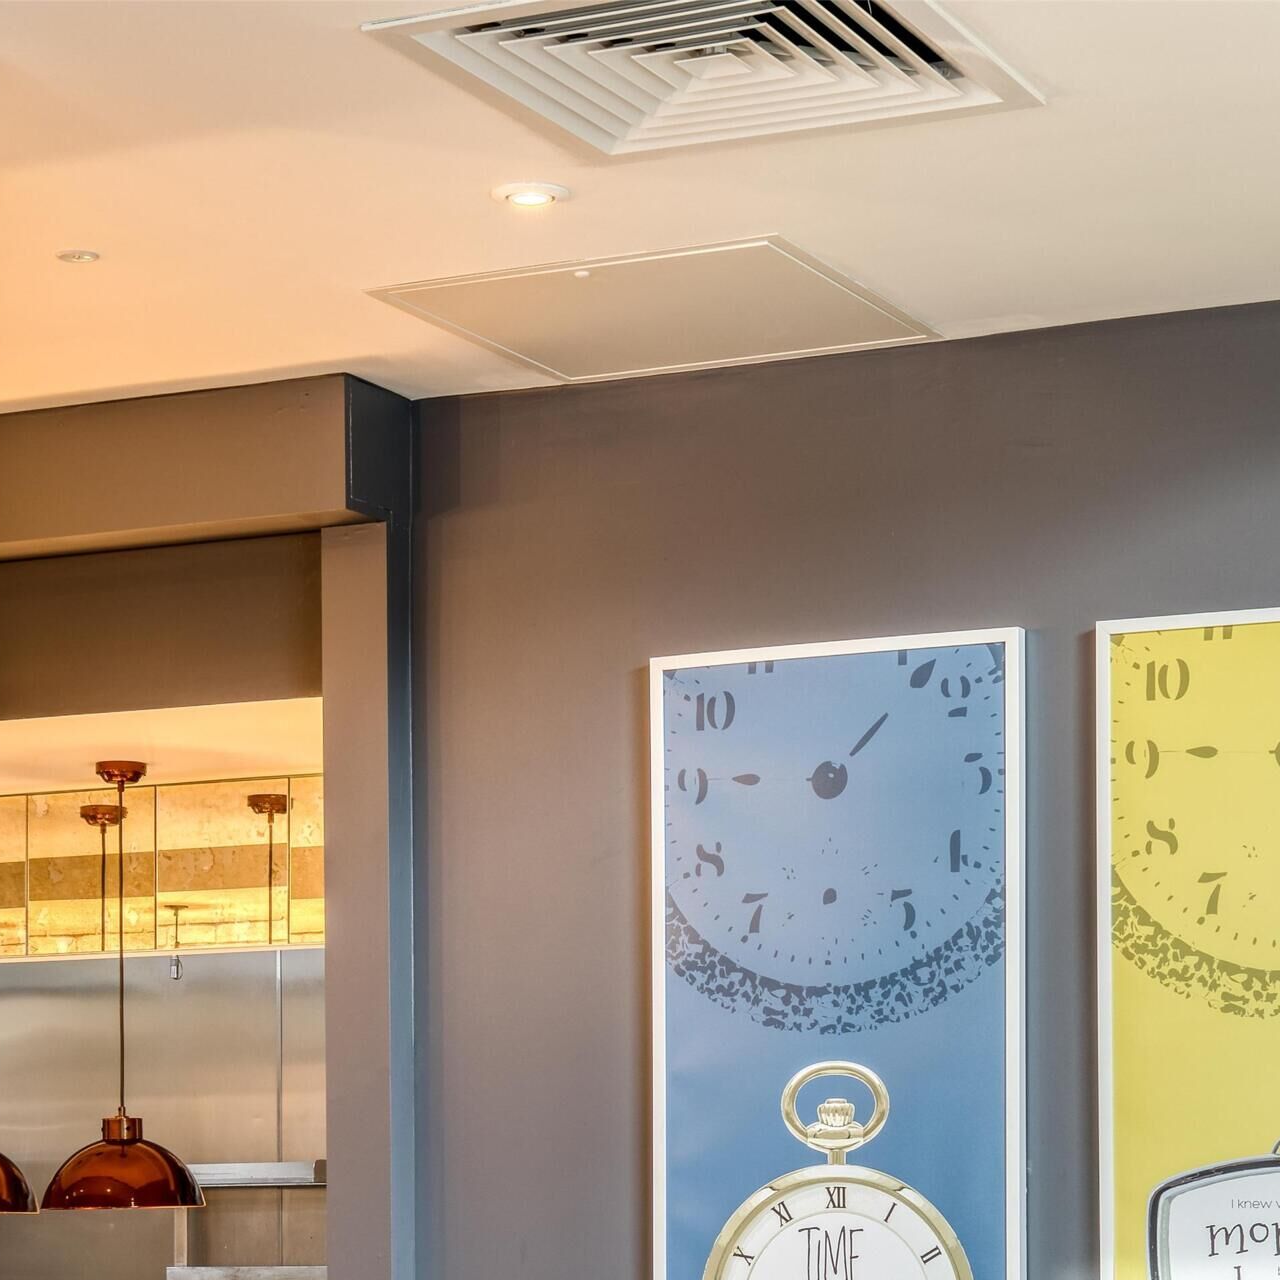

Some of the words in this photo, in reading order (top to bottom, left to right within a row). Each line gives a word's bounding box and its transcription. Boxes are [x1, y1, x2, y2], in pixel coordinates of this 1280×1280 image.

[826, 1187, 846, 1208] XII
[1237, 1199, 1276, 1209] knew
[733, 1246, 755, 1266] X
